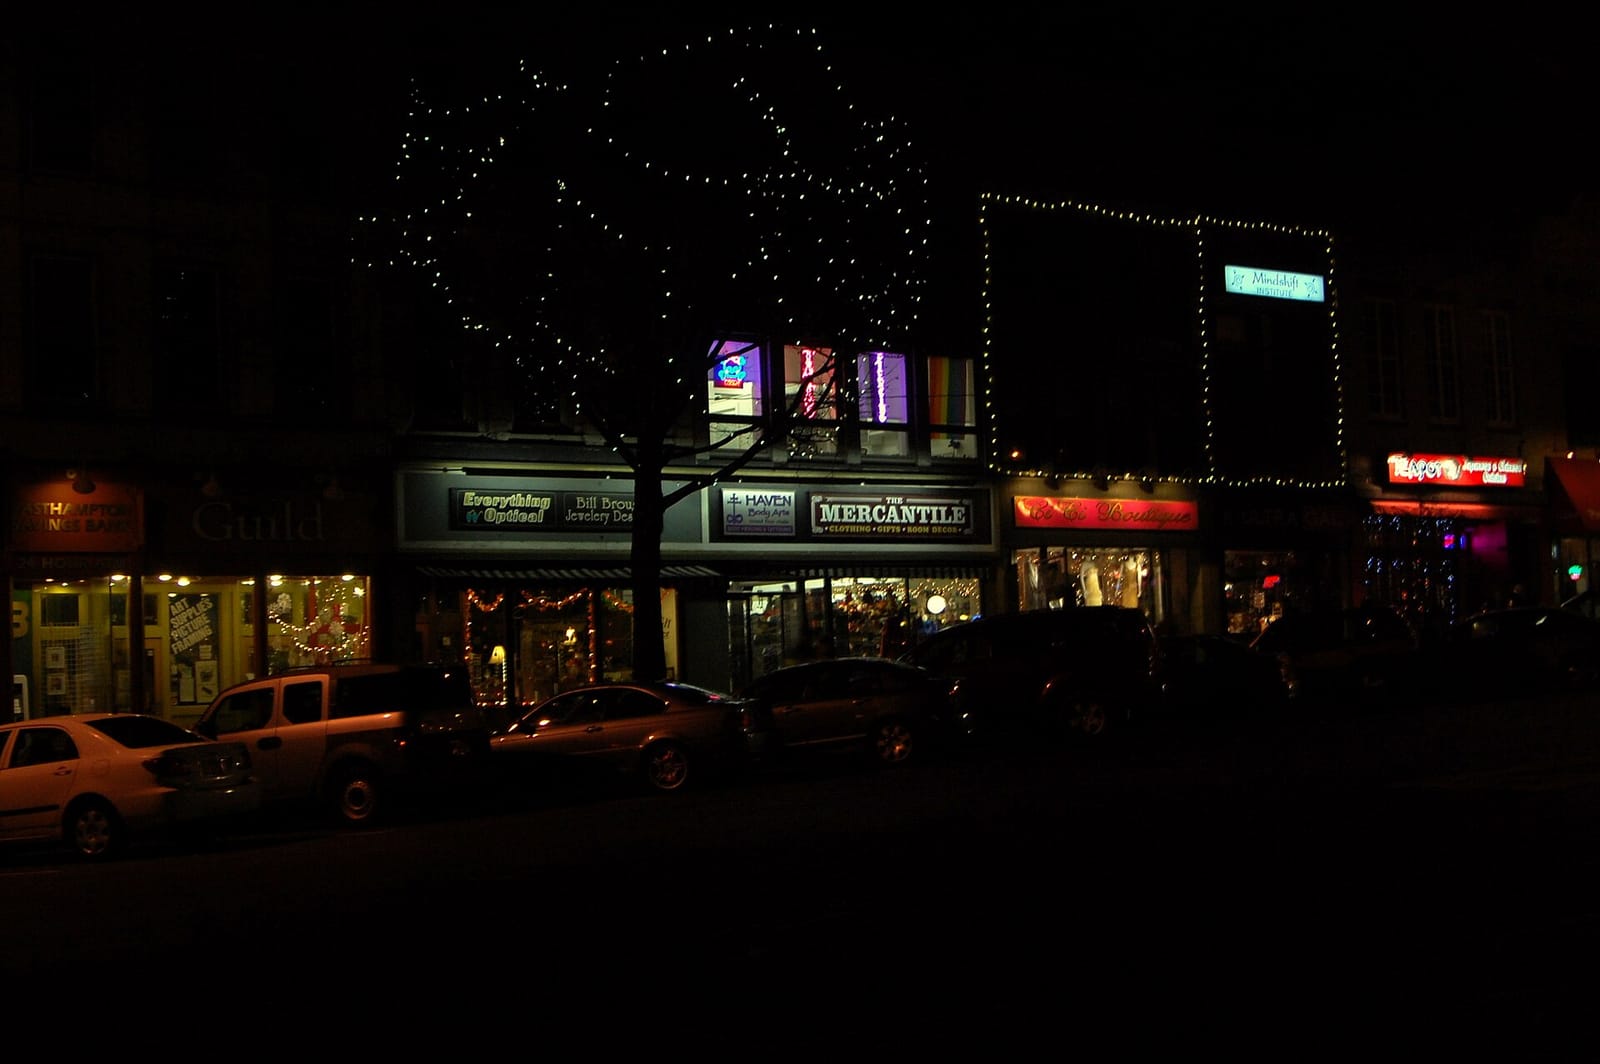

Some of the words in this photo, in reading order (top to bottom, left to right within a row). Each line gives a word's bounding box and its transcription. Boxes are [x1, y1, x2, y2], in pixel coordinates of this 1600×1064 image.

[1252, 271, 1299, 290] Mindshift
[1256, 287, 1293, 298] INSTITUTE
[15, 501, 129, 517] ASTHAMPTON
[463, 490, 551, 510] Everything
[576, 497, 597, 510] Bill
[745, 494, 791, 507] HAVEN
[885, 496, 904, 505] THE
[192, 496, 326, 543] Guild
[484, 508, 544, 525] Optical
[747, 507, 771, 518] Body
[819, 503, 966, 524] MERCANTILE
[1096, 501, 1191, 529] Boutique
[829, 525, 871, 533] CLOTHING
[877, 526, 901, 534] GIFTS
[932, 526, 957, 534] DECOR
[170, 596, 191, 617] ART
[170, 598, 214, 629] SUPPLIES
[170, 612, 211, 641] PICTURE
[171, 625, 213, 656] FRAMING
